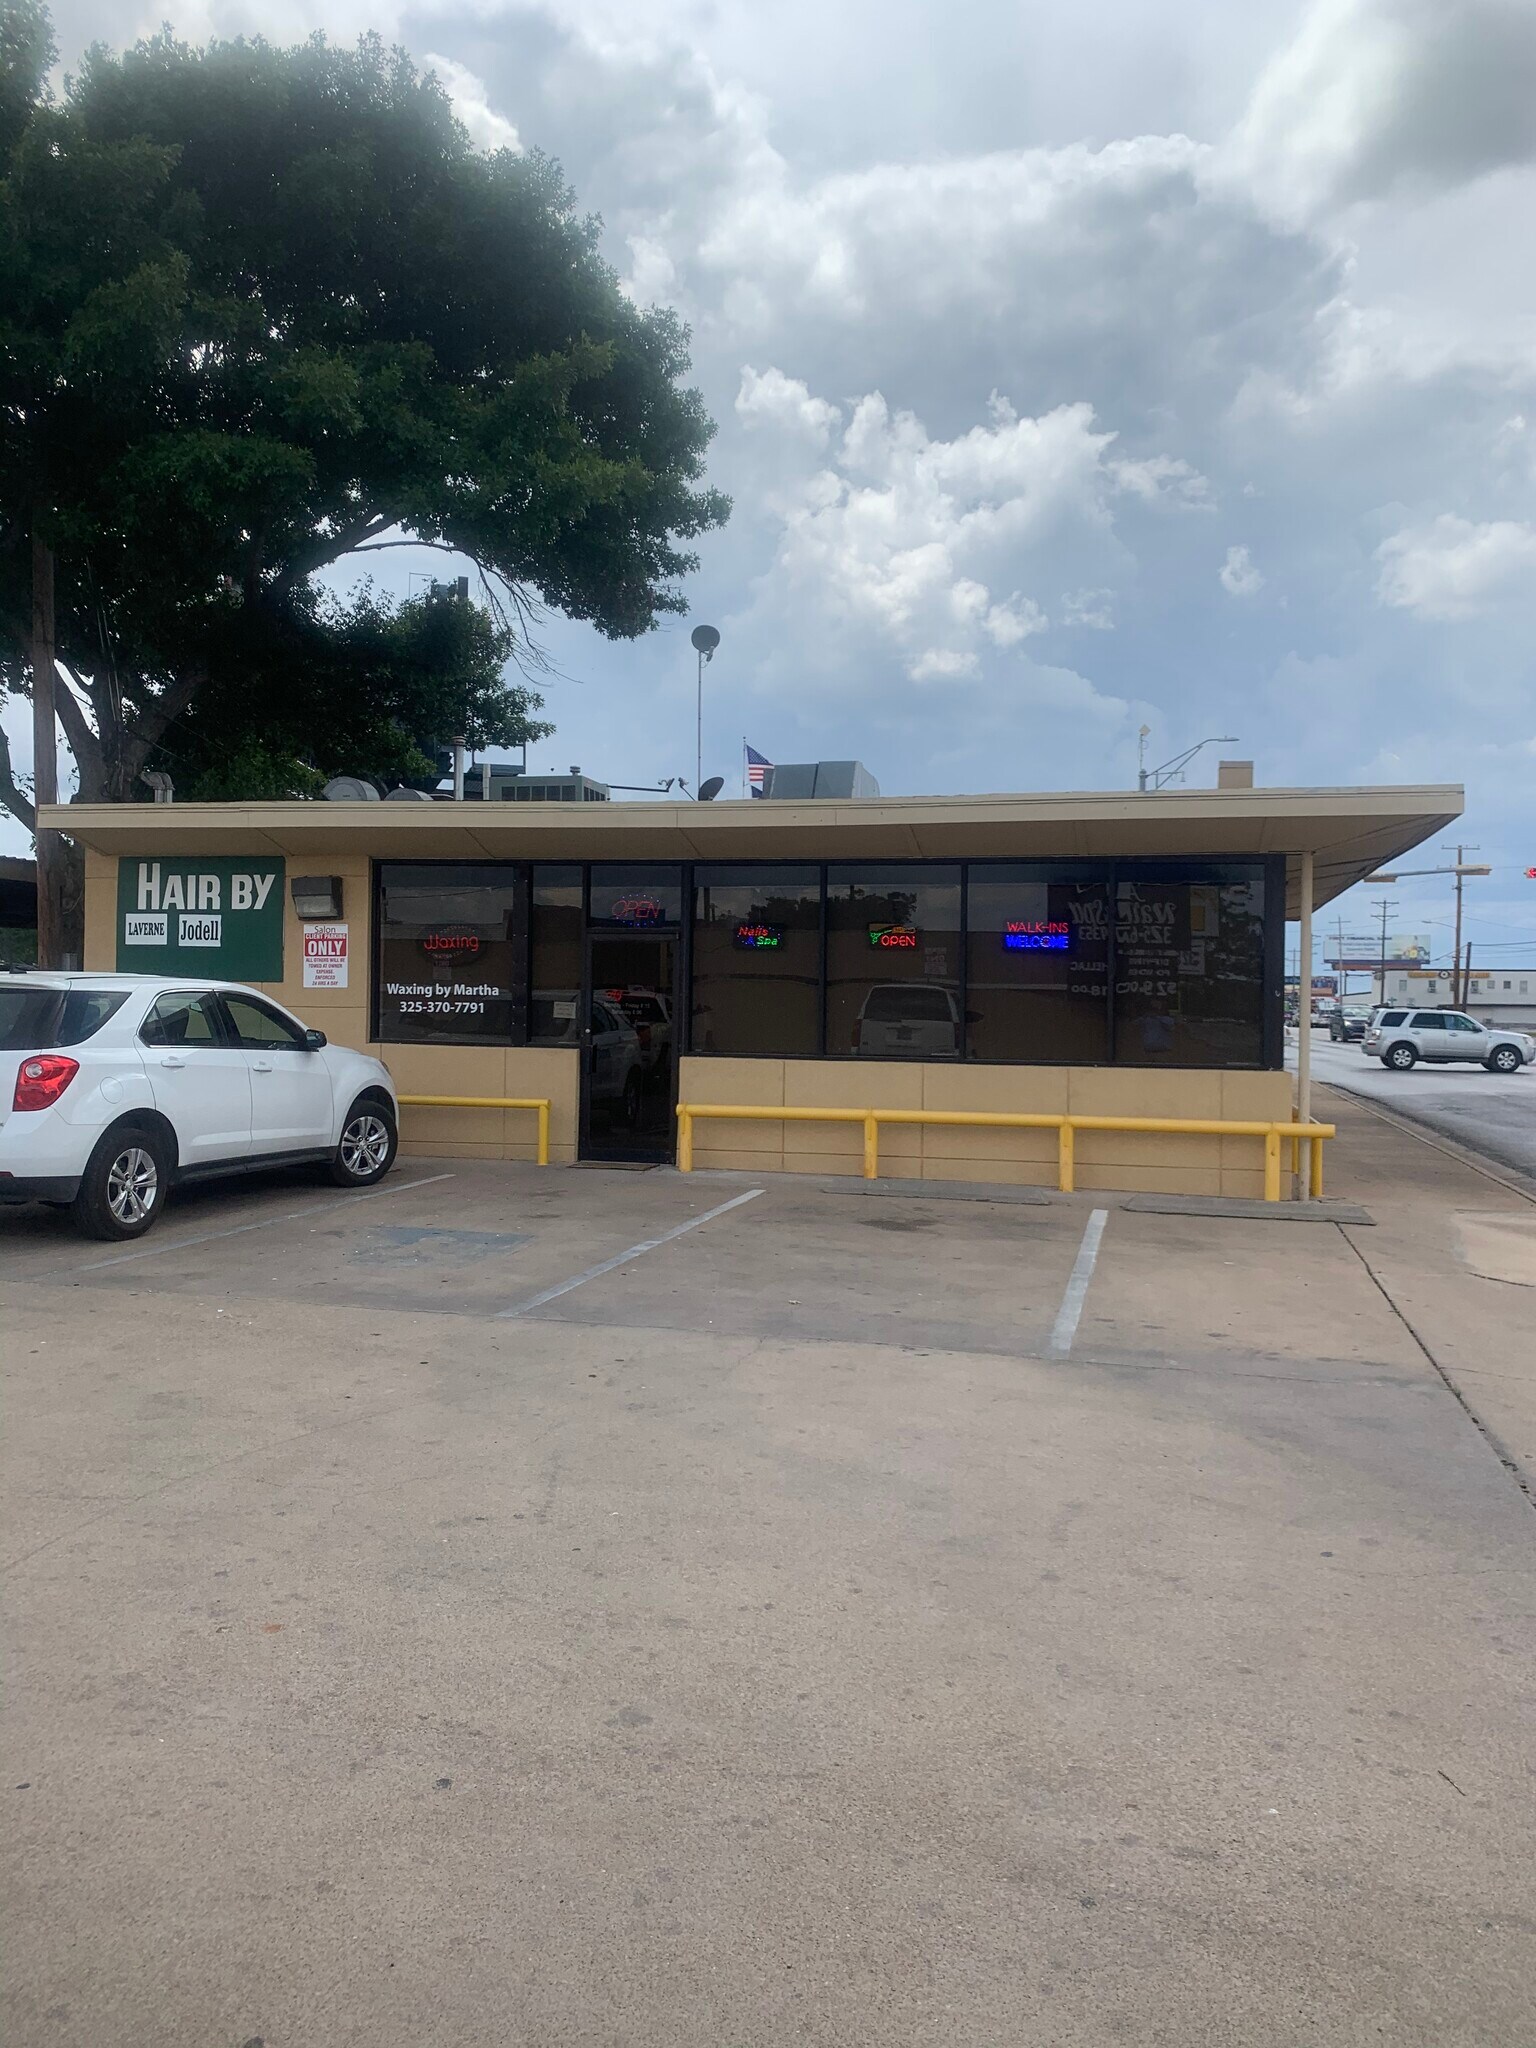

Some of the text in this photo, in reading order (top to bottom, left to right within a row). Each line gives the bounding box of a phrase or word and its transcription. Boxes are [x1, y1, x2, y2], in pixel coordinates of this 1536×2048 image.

[137, 863, 276, 910] HAIR BY
[612, 900, 660, 918] OPEN
[128, 922, 165, 936] LAVERNE
[180, 920, 219, 941] Jodell
[314, 925, 336, 934] Salon
[738, 926, 769, 937] Nails
[1006, 921, 1069, 933] WALK-INS
[308, 940, 344, 956] ONLY
[423, 933, 479, 952] Waxing
[756, 936, 778, 946] Spa
[881, 935, 916, 947] OPEN
[1005, 934, 1069, 949] WELCOME
[387, 983, 500, 998] Waxing by Martha
[399, 1001, 485, 1014] 325-370-7791
